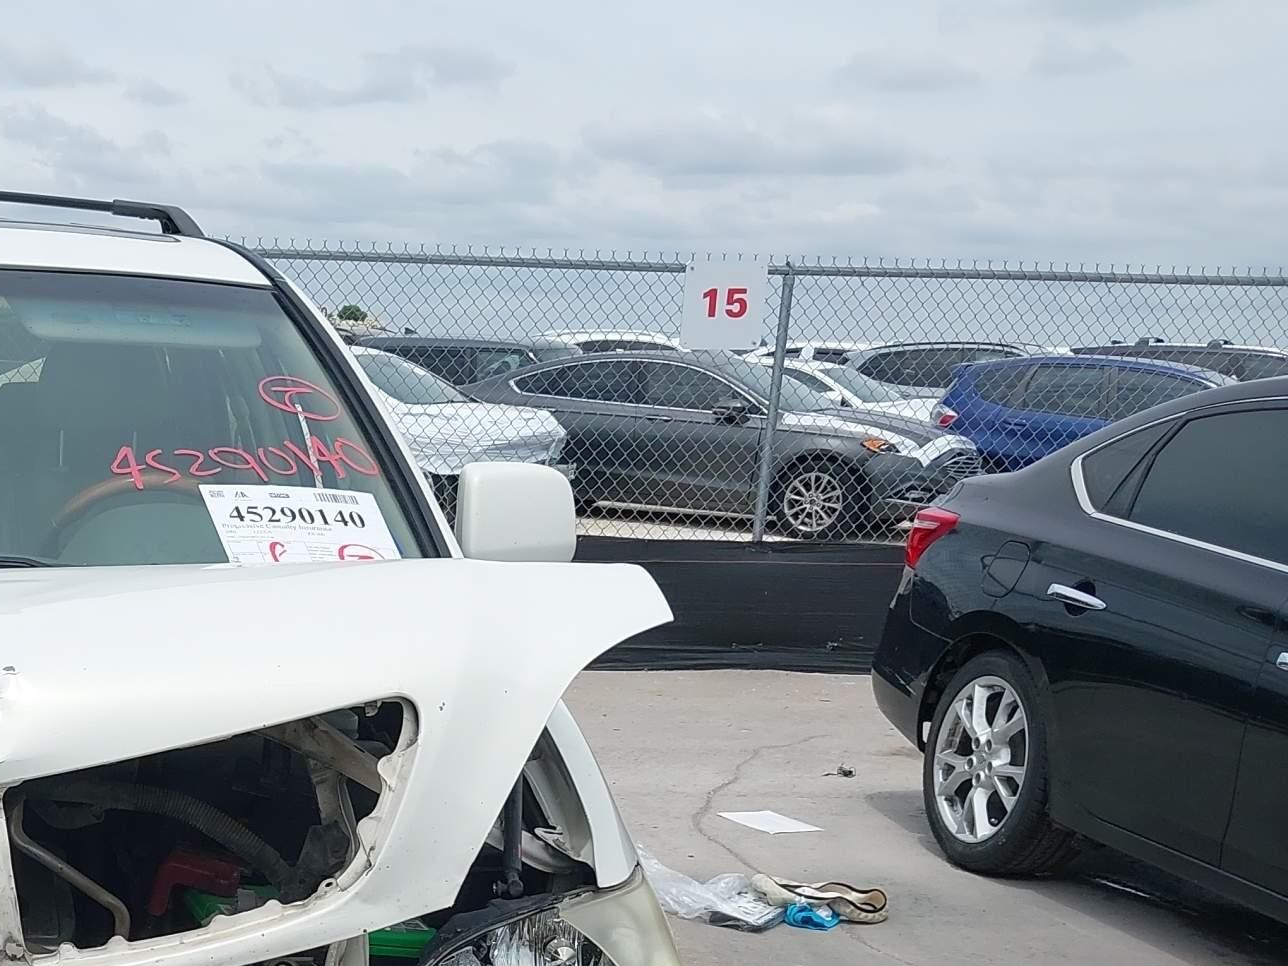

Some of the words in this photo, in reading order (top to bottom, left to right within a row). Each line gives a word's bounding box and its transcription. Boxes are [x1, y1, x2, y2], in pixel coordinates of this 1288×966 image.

[702, 287, 748, 318] 15
[110, 436, 380, 490] 45290140
[229, 505, 366, 529] 45290140
